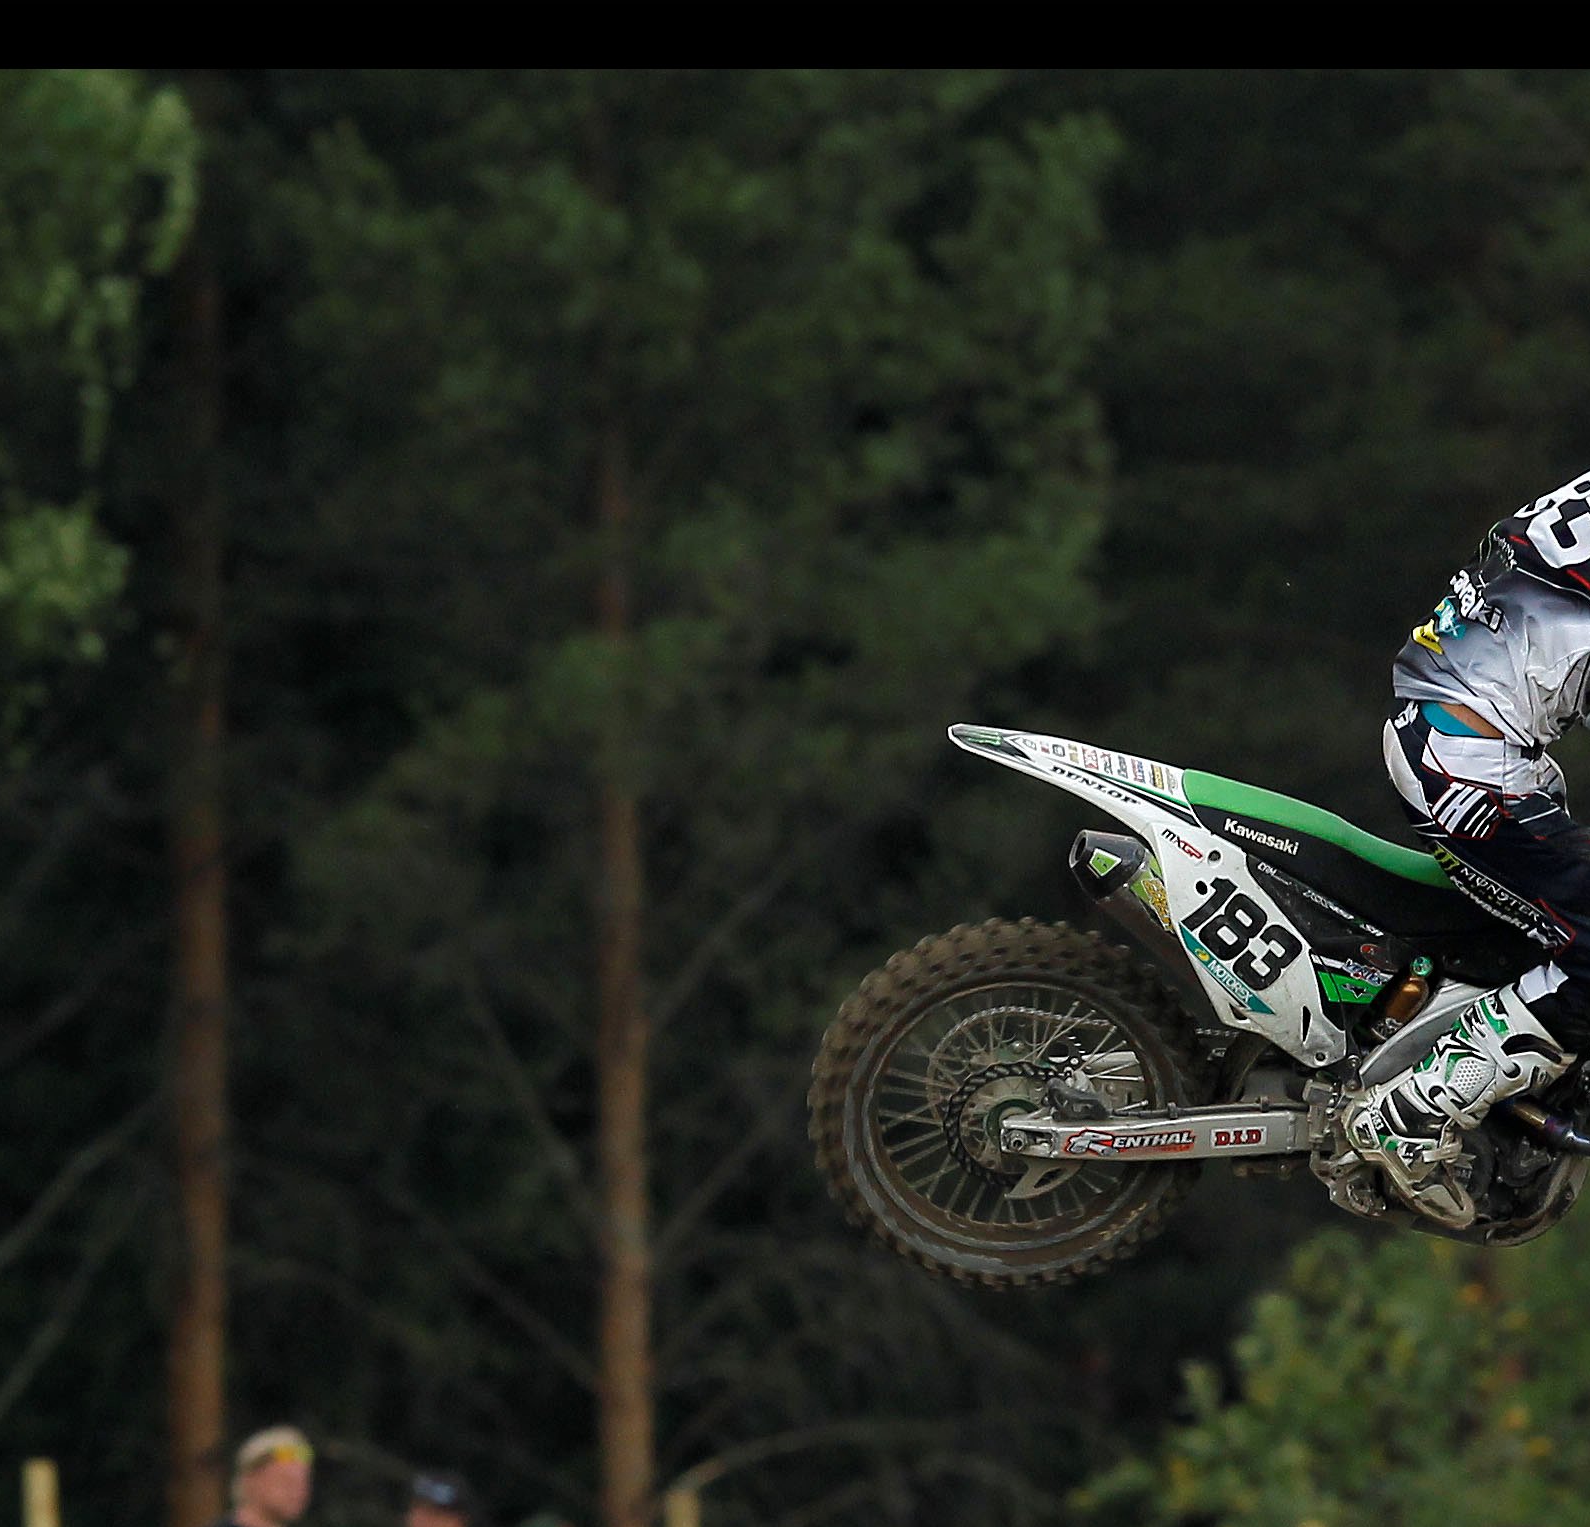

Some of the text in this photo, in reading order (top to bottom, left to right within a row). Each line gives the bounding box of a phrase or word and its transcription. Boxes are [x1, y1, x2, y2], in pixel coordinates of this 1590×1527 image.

[1050, 765, 1140, 805] DUNLOP
[1224, 817, 1300, 856] Kawasaki
[1460, 866, 1540, 921] MONSTER
[1180, 876, 1303, 992] 183
[1207, 959, 1252, 1002] MOTOREX
[1068, 1129, 1195, 1156] RENTHAL
